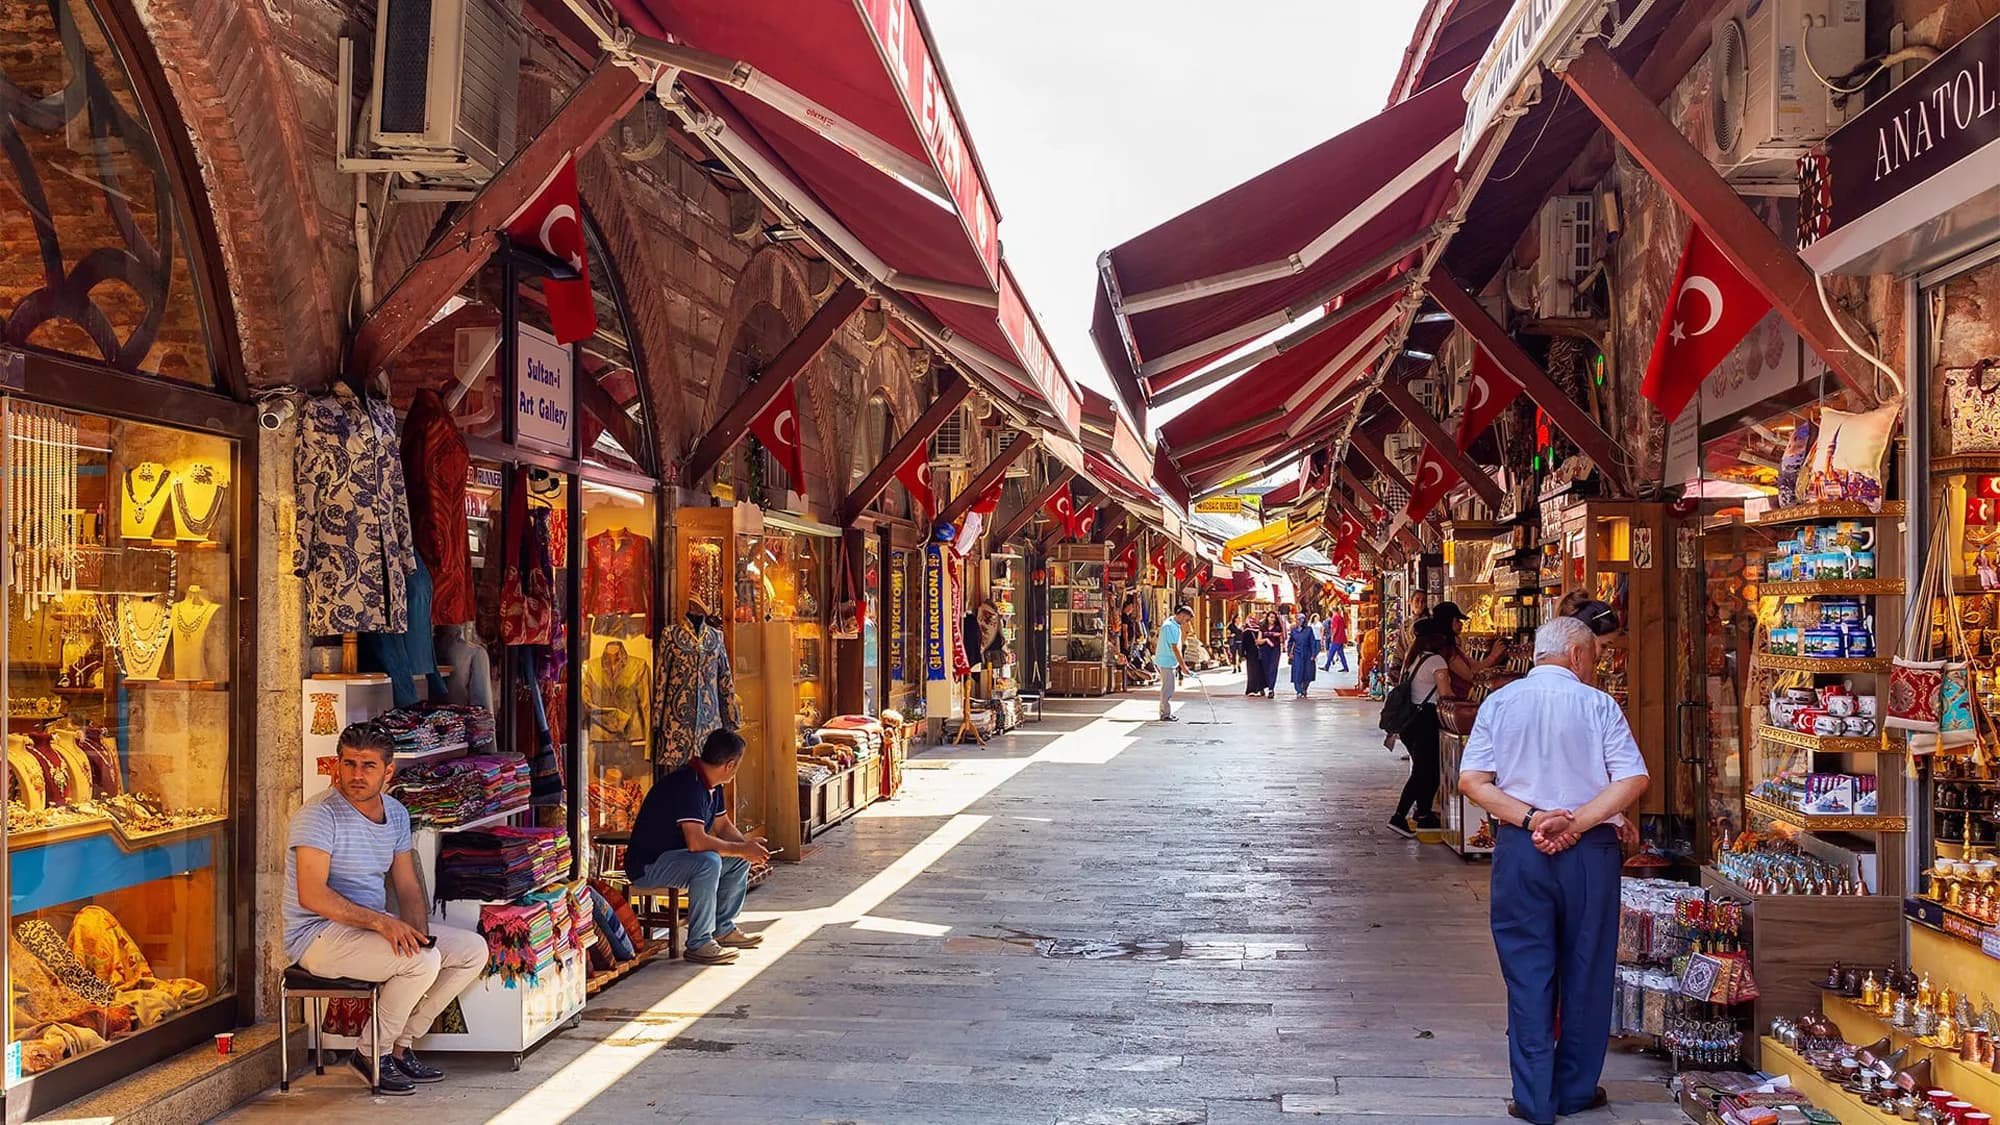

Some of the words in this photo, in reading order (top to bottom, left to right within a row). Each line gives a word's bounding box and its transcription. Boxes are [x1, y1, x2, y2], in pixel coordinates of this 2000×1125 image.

[1874, 60, 2000, 182] ANATOL
[527, 357, 560, 389] Sultan-i
[519, 391, 534, 416] Art
[538, 397, 568, 431] Gallery
[1202, 501, 1219, 510] MOSAIC
[1219, 501, 1239, 510] MUSEUM
[928, 569, 940, 640] BARCELONA
[929, 642, 940, 656] FC
